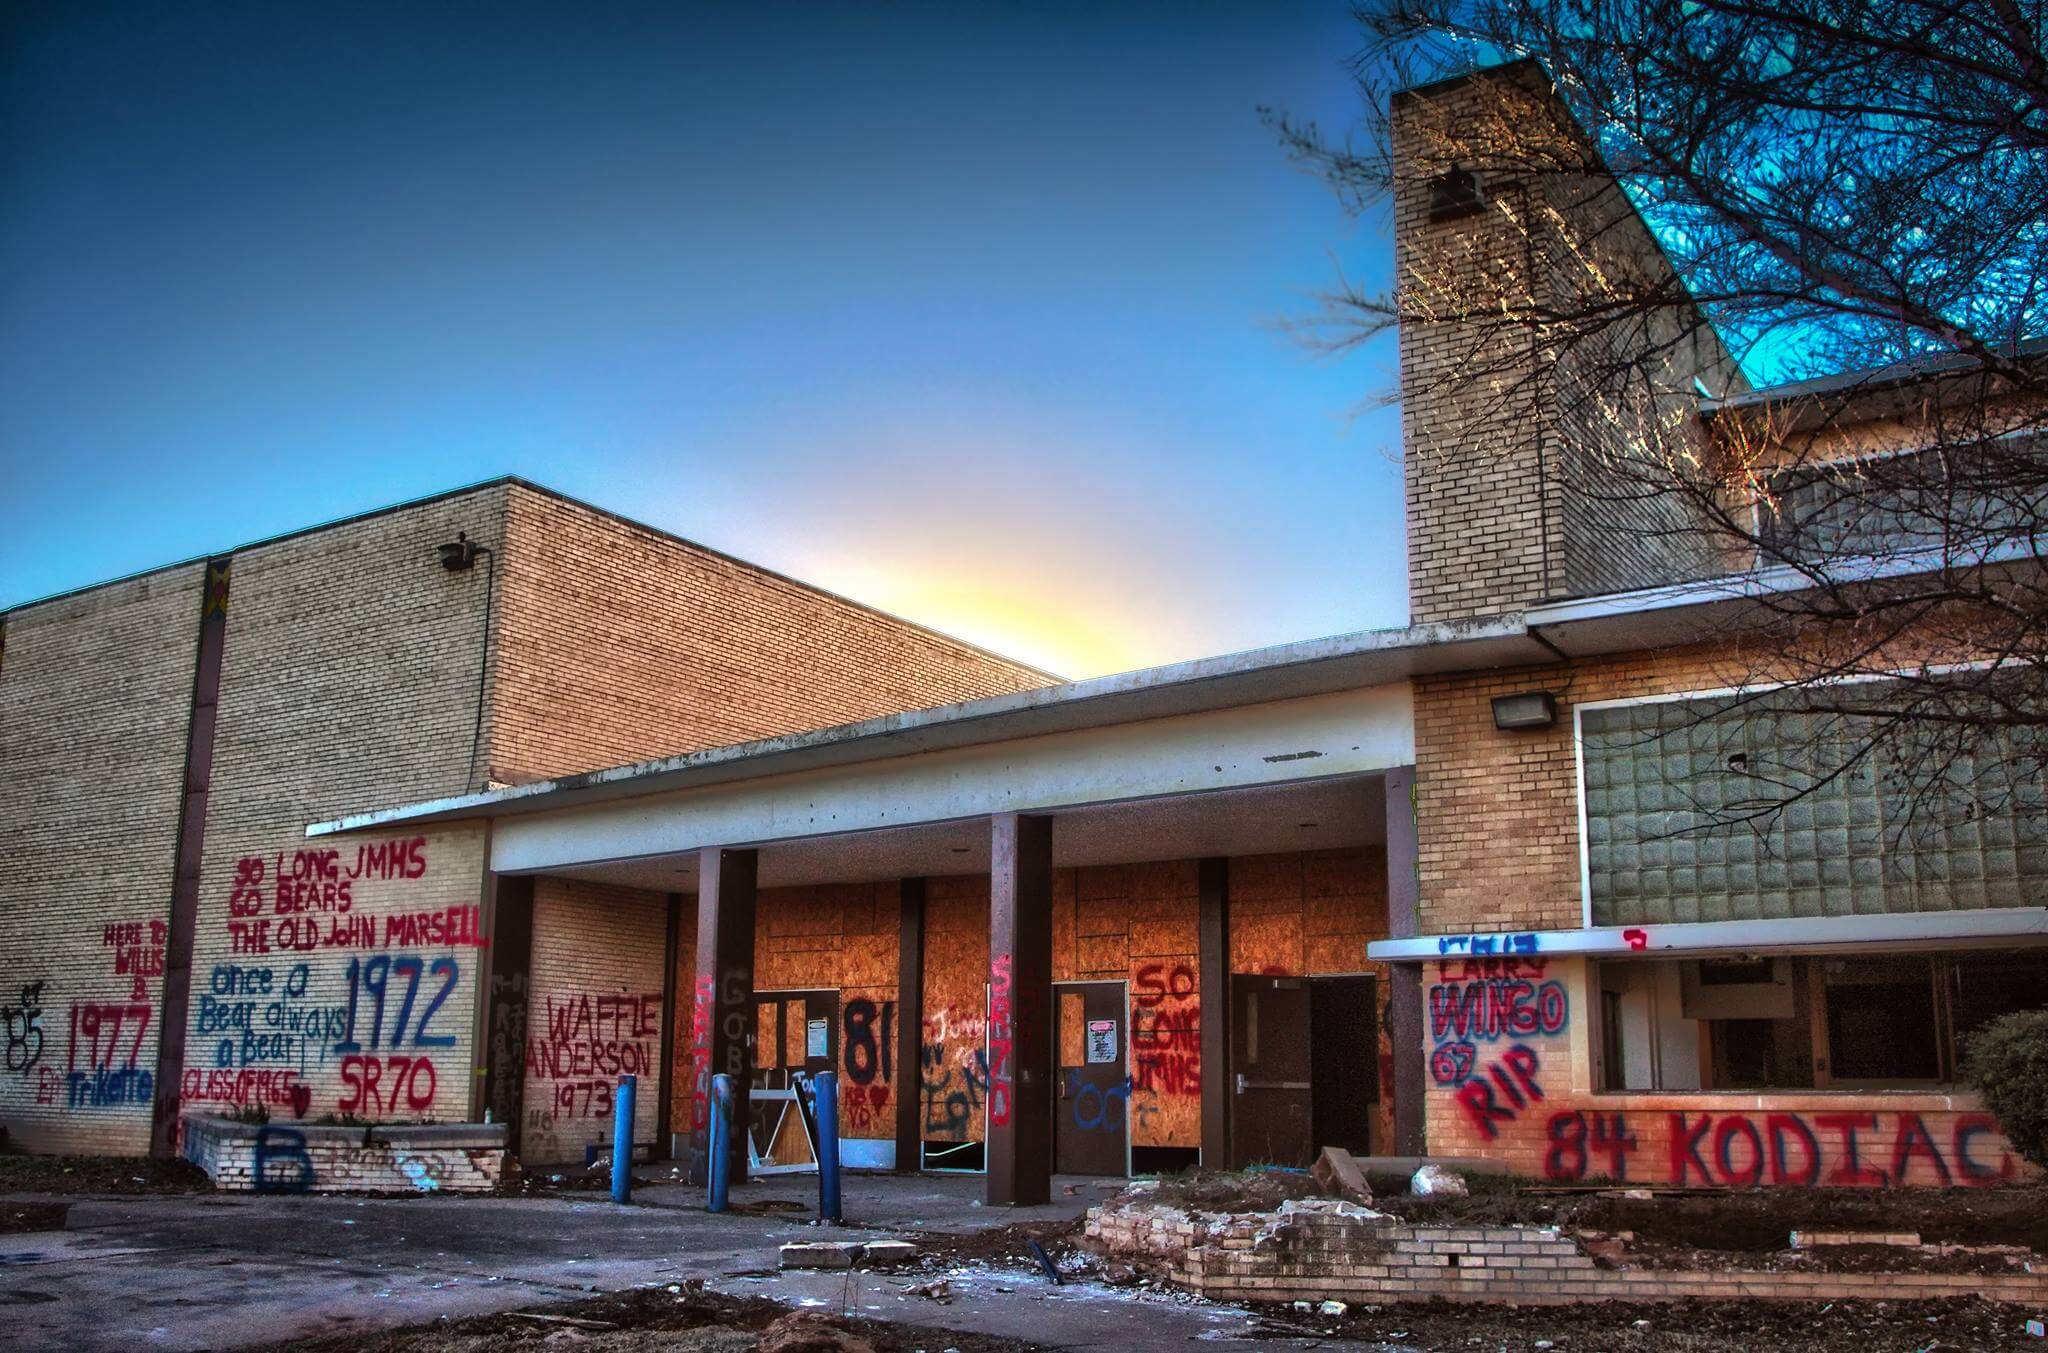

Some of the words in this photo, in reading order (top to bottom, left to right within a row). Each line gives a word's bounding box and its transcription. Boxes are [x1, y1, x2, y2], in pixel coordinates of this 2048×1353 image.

[235, 858, 264, 884] SO
[277, 850, 339, 883] LONG
[345, 838, 426, 879] JMHS
[230, 887, 261, 917] GO
[275, 880, 352, 914] BEARS
[228, 921, 271, 954] THE
[277, 917, 318, 951] OLD
[335, 955, 459, 1053] 1972
[1136, 964, 1195, 1007] SO
[1429, 979, 1569, 1041] WINGO
[68, 1002, 151, 1073] 1977
[196, 994, 256, 1034] Bear
[265, 989, 347, 1048] always
[845, 997, 894, 1085] 81
[182, 1068, 234, 1101] CLASS
[526, 1040, 651, 1079] ANDERSON
[554, 1081, 614, 1121] 1973
[1455, 1044, 1544, 1141] RIP
[1544, 1109, 1637, 1182] 84
[1667, 1109, 2016, 1187] KODIAC
